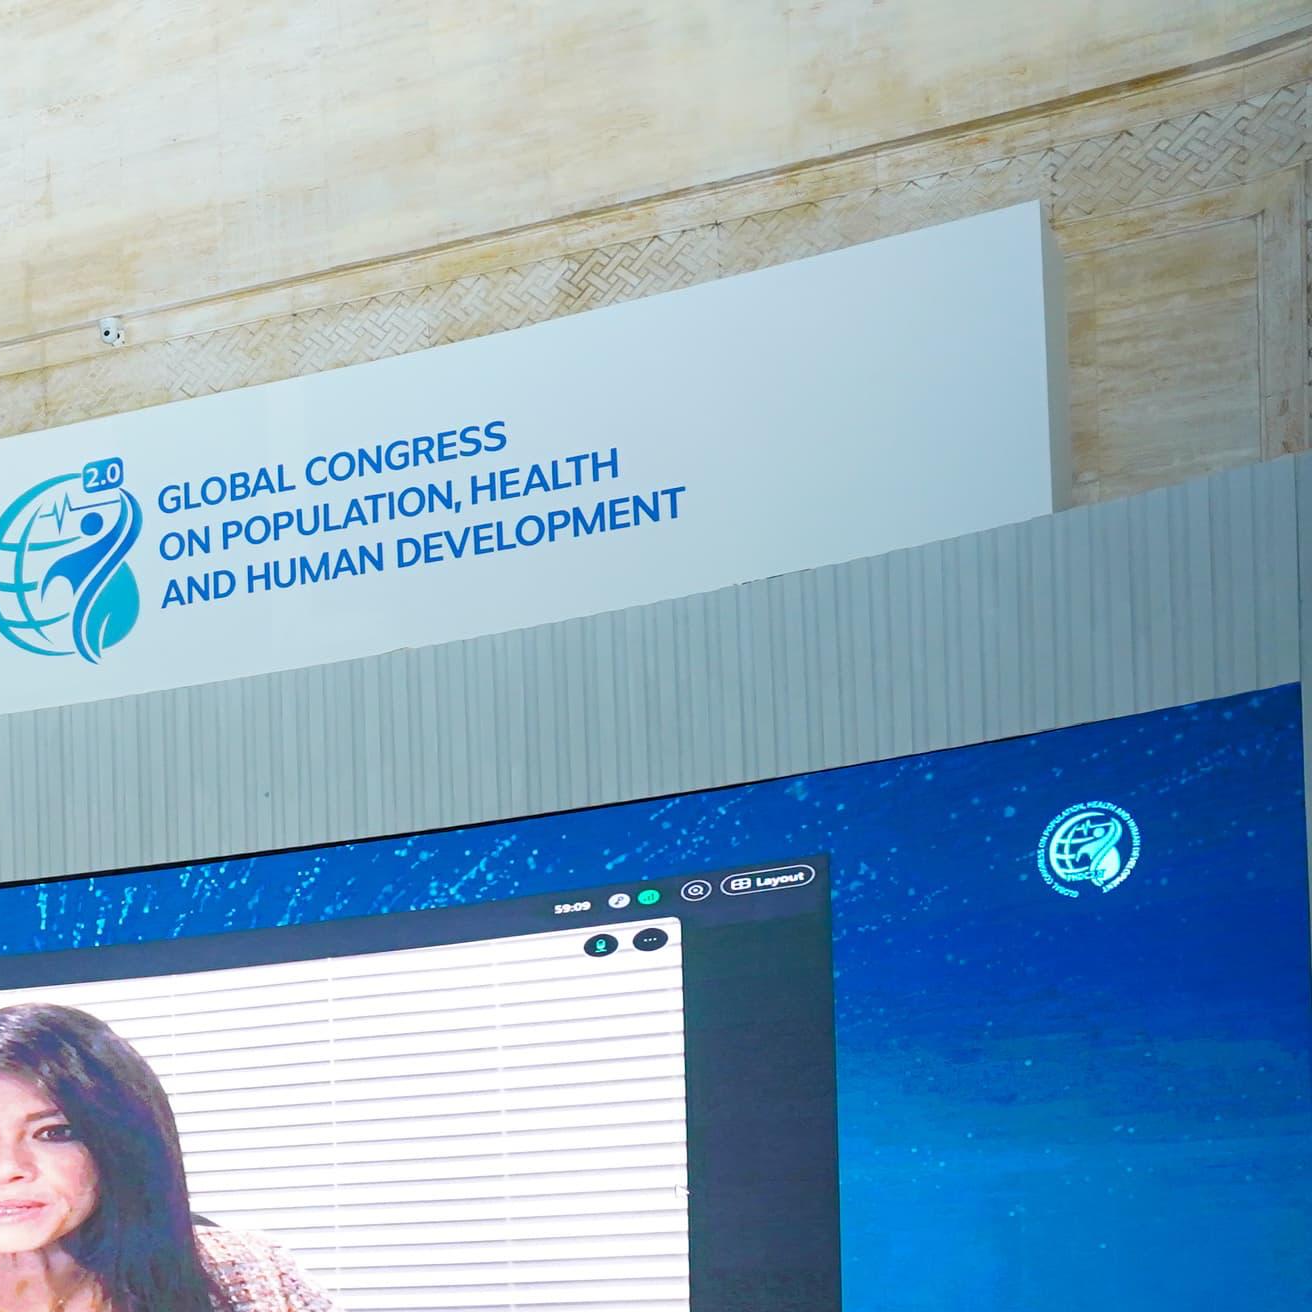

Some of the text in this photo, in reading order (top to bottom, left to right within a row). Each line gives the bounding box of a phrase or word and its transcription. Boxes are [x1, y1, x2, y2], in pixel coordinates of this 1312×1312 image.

[85, 463, 121, 488] 2.0
[157, 421, 507, 514] GLOBAL CONGRESS
[159, 447, 619, 561] ON POPULATION, HEALTH
[161, 486, 686, 609] AND HUMAN DEVELOPMENT
[554, 901, 592, 914] 59:09
[755, 871, 805, 888] Layout
